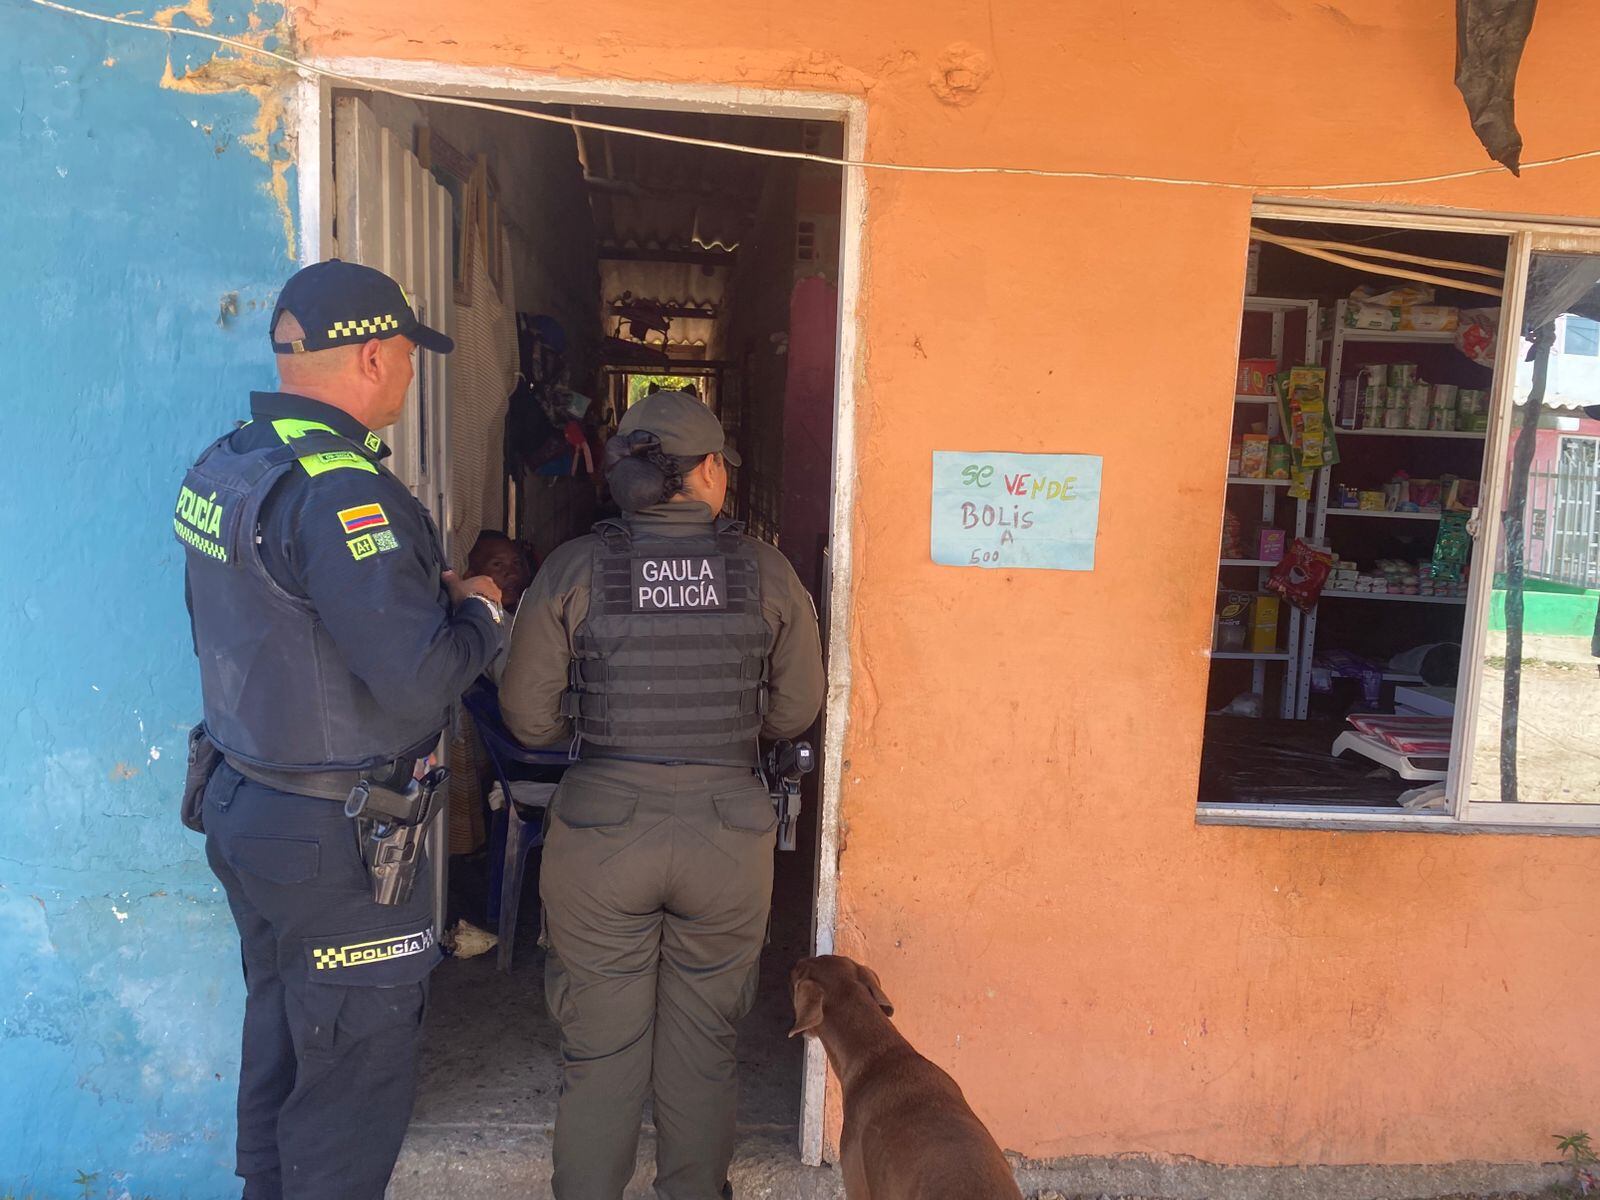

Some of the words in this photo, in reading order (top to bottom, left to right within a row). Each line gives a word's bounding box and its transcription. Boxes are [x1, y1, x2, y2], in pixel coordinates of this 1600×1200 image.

[1004, 473, 1077, 501] VENDE
[175, 485, 223, 539] POLICÍA
[1000, 529, 1014, 546] A
[969, 548, 999, 564] 500
[642, 559, 714, 582] GAULA
[639, 580, 719, 608] POLICÍA
[350, 939, 420, 963] POLICÍA
